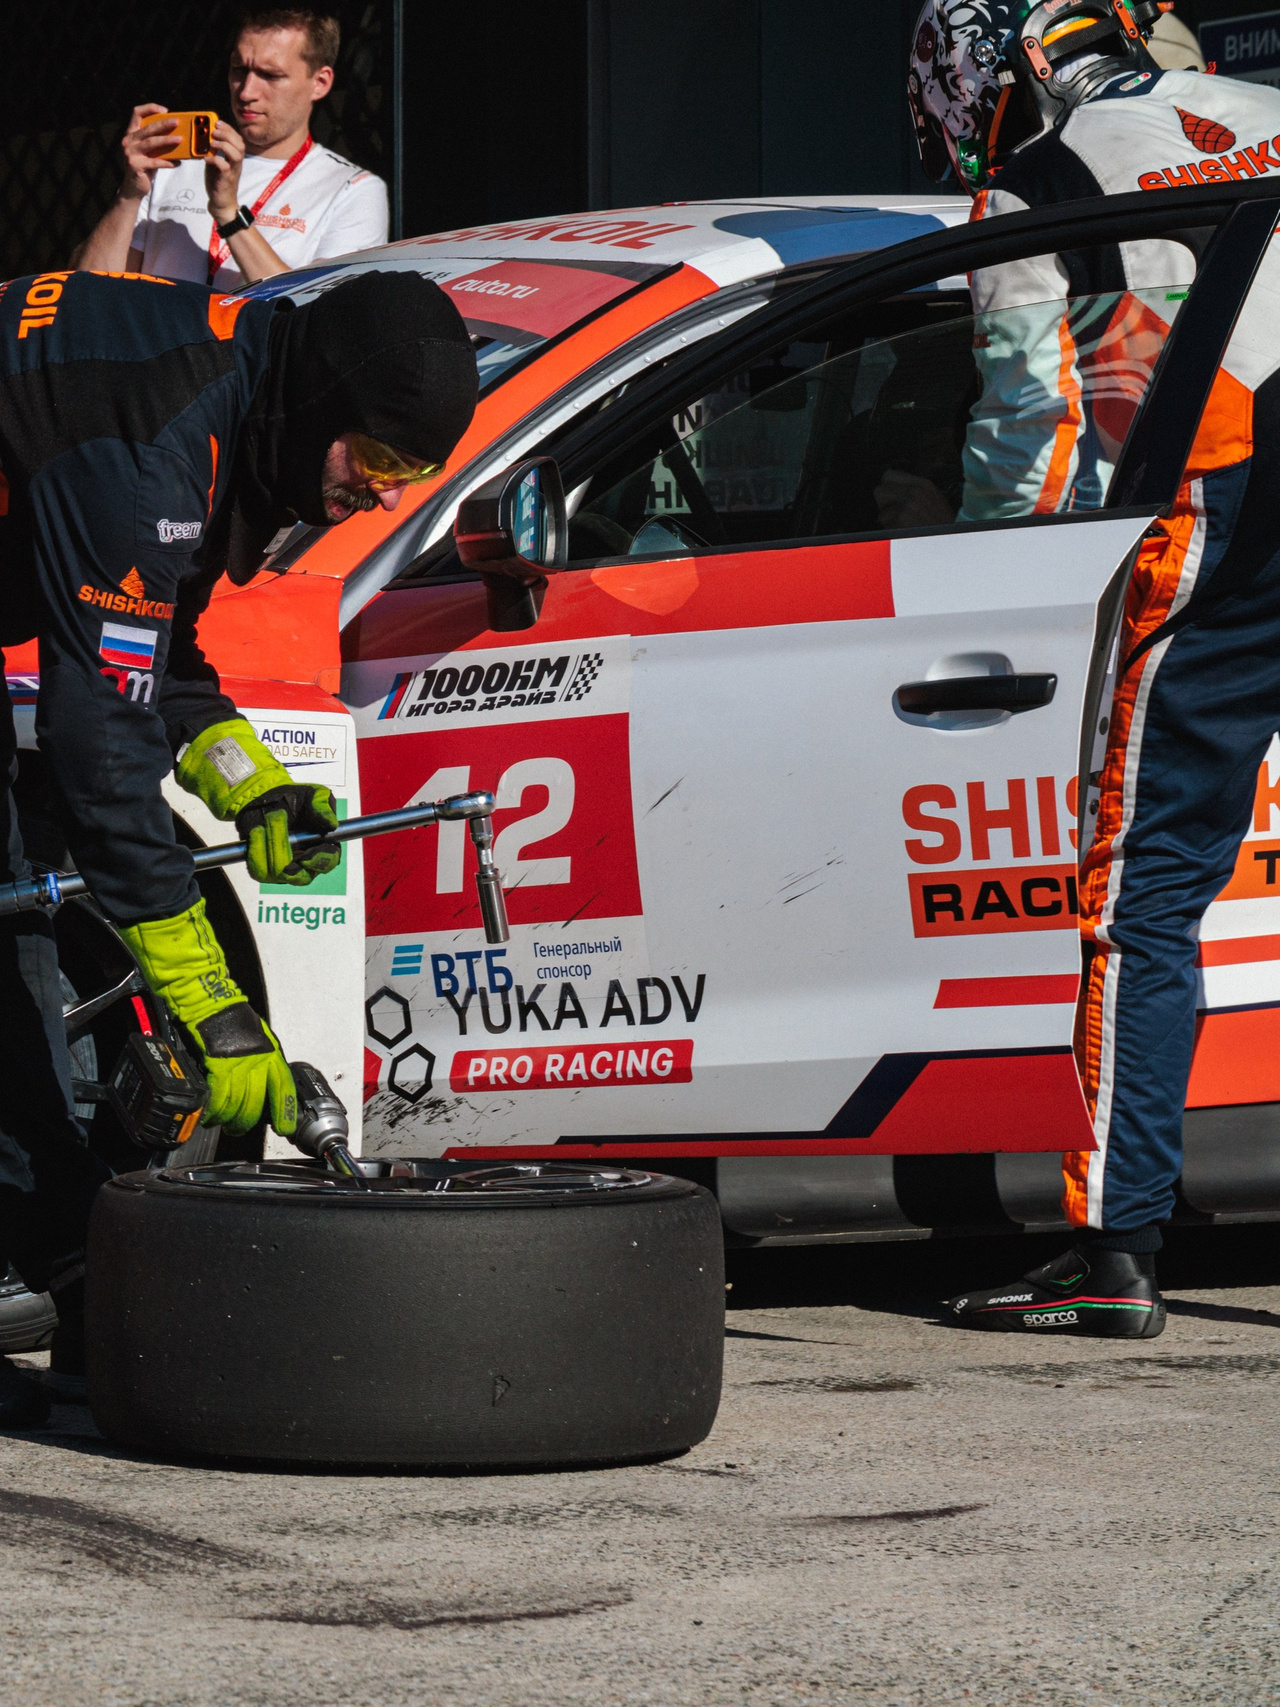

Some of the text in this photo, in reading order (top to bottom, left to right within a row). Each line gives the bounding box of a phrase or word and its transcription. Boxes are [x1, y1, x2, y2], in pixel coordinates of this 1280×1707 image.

[451, 279, 540, 299] auto.ru
[157, 519, 202, 543] freem
[406, 689, 556, 718] ИГОРА ДРАЙВ
[261, 728, 316, 745] ACTION
[292, 746, 337, 759] SAFETY
[402, 757, 576, 894] 12
[901, 774, 1078, 866] SHI
[257, 901, 347, 930] integra
[532, 936, 622, 960] Генеральный
[430, 948, 514, 998] ВТБ
[536, 962, 592, 982] спонсор
[443, 973, 706, 1036] YUKA ADV
[467, 1047, 675, 1086] PRO RACING
[1023, 1310, 1078, 1326] sparco
